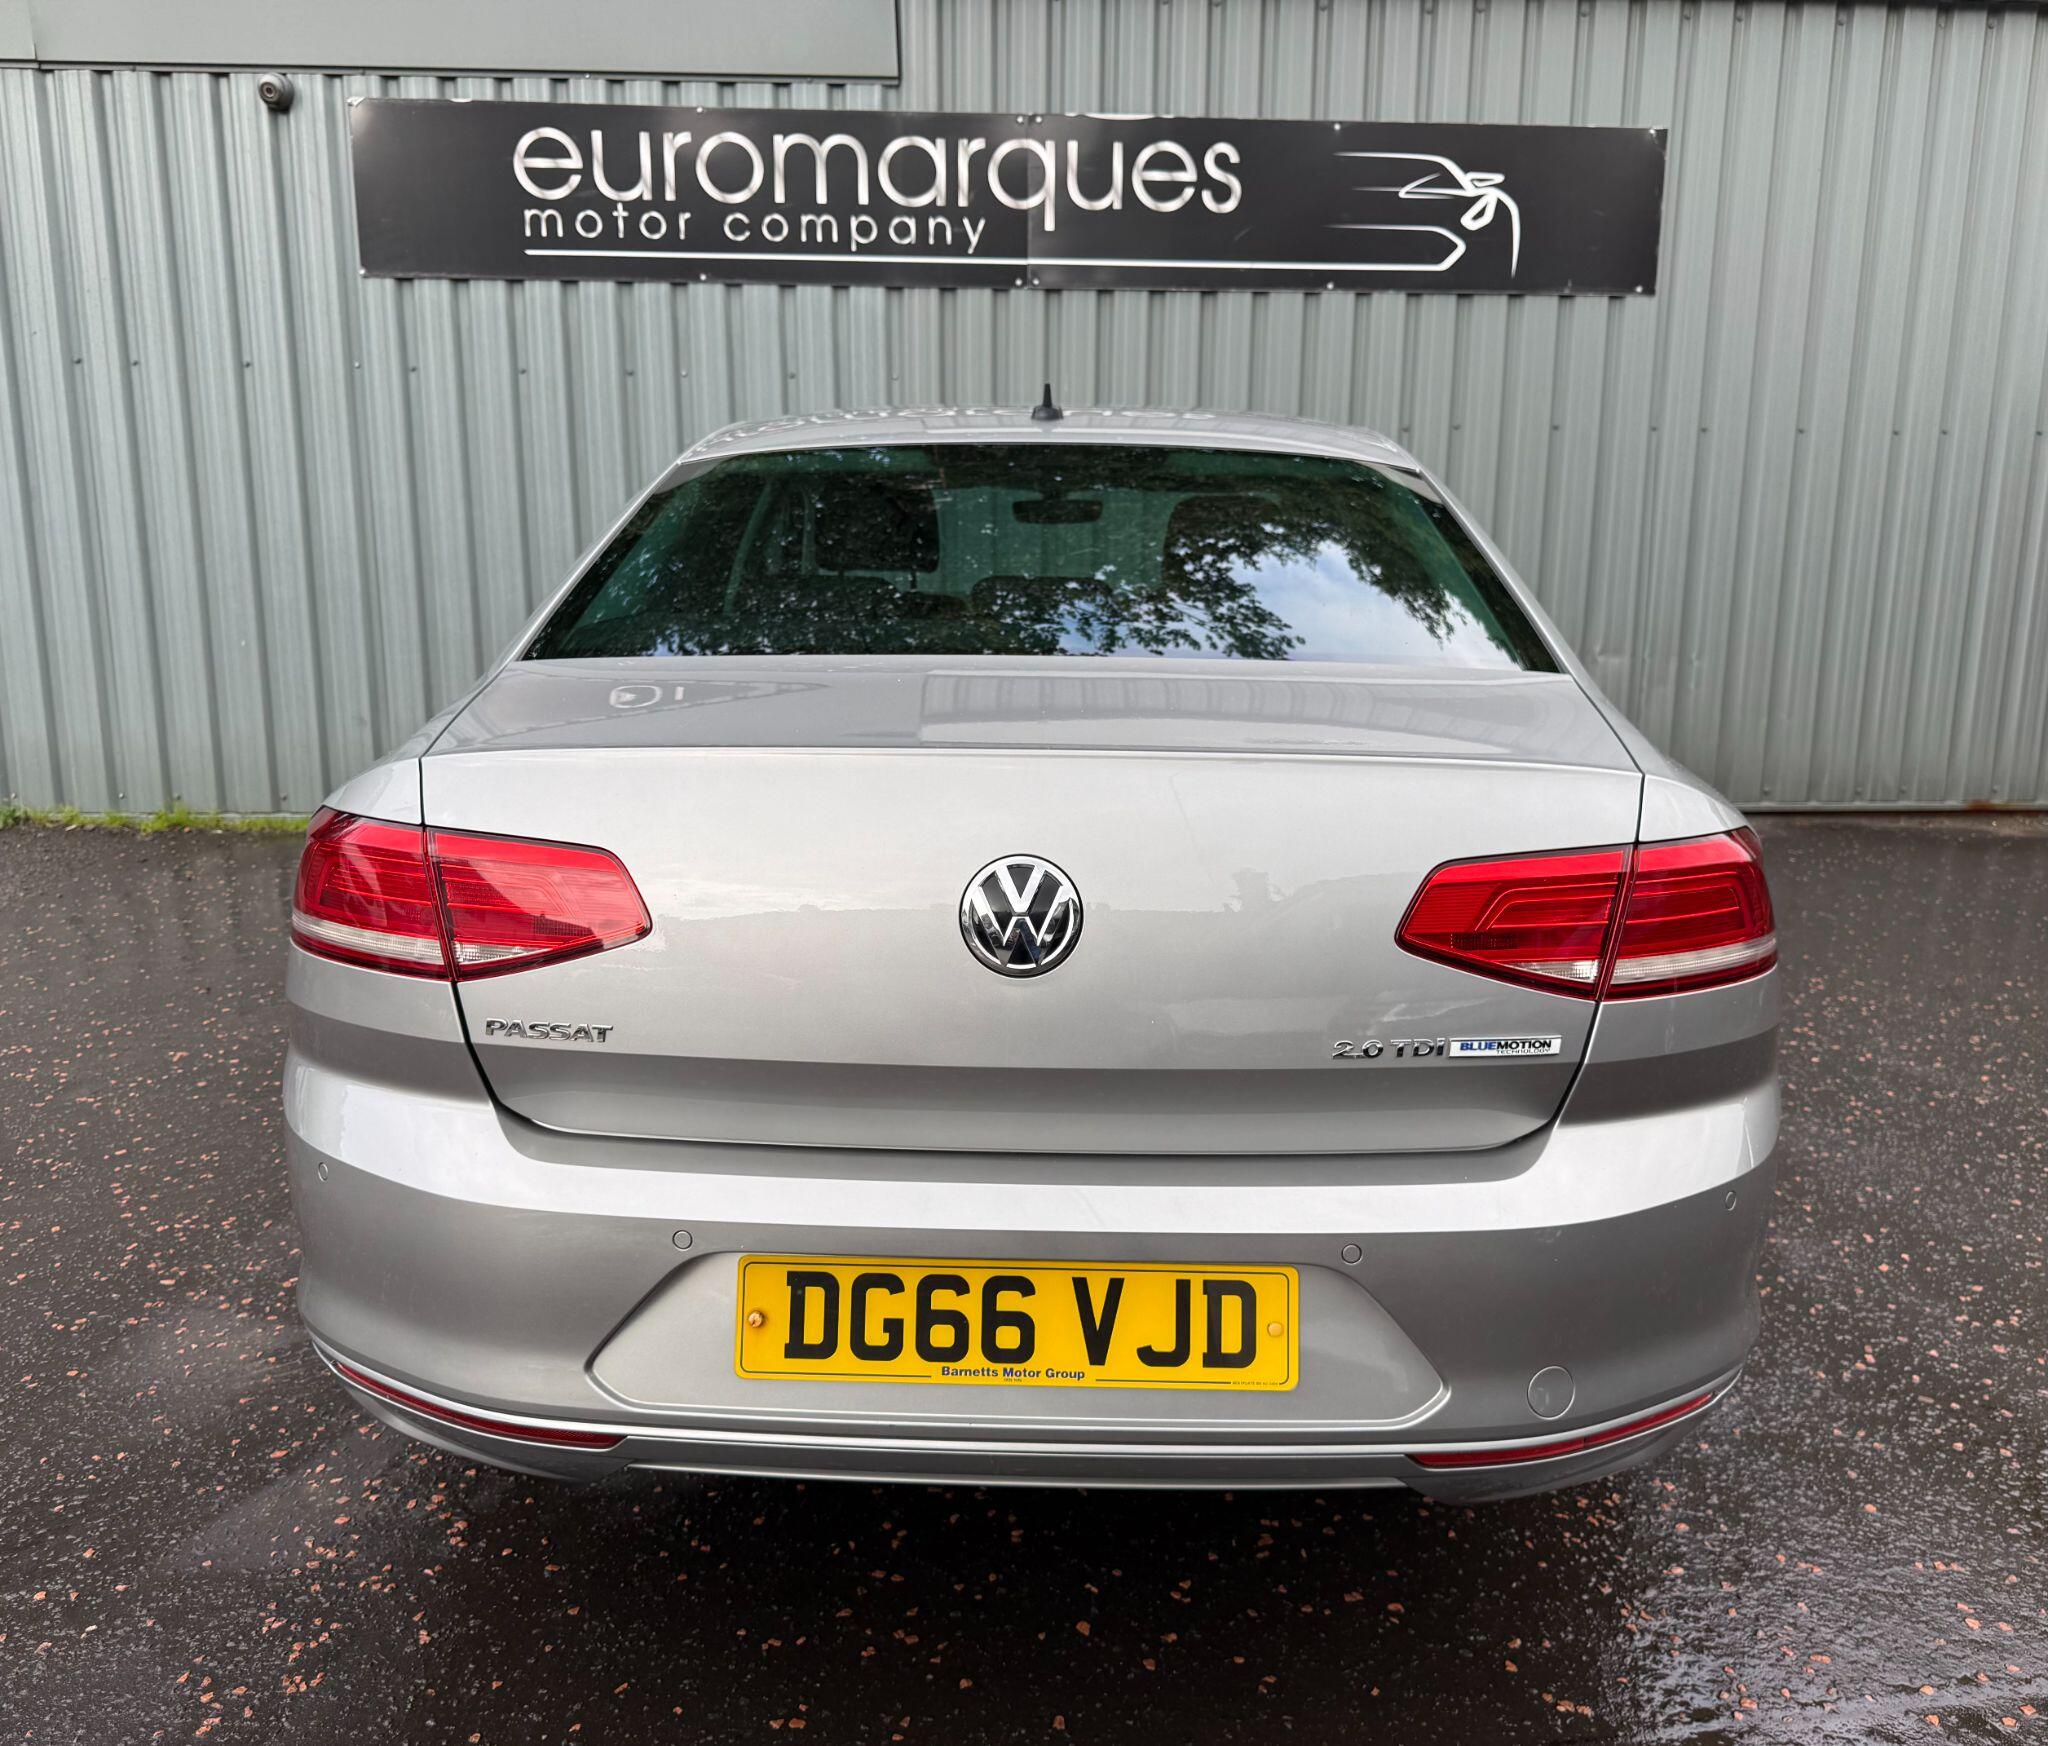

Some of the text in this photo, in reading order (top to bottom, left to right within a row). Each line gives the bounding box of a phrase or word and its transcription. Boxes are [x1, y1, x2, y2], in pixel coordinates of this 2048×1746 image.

[512, 126, 1242, 232] euromarques
[523, 201, 987, 255] motor company
[485, 1017, 614, 1043] PASSAT
[1332, 1039, 1384, 1060] 2.0
[1460, 1040, 1552, 1051] BLUEMOTION
[784, 1270, 1257, 1369] DG66 VJD
[941, 1366, 1085, 1381] Barnetts Motor Group
